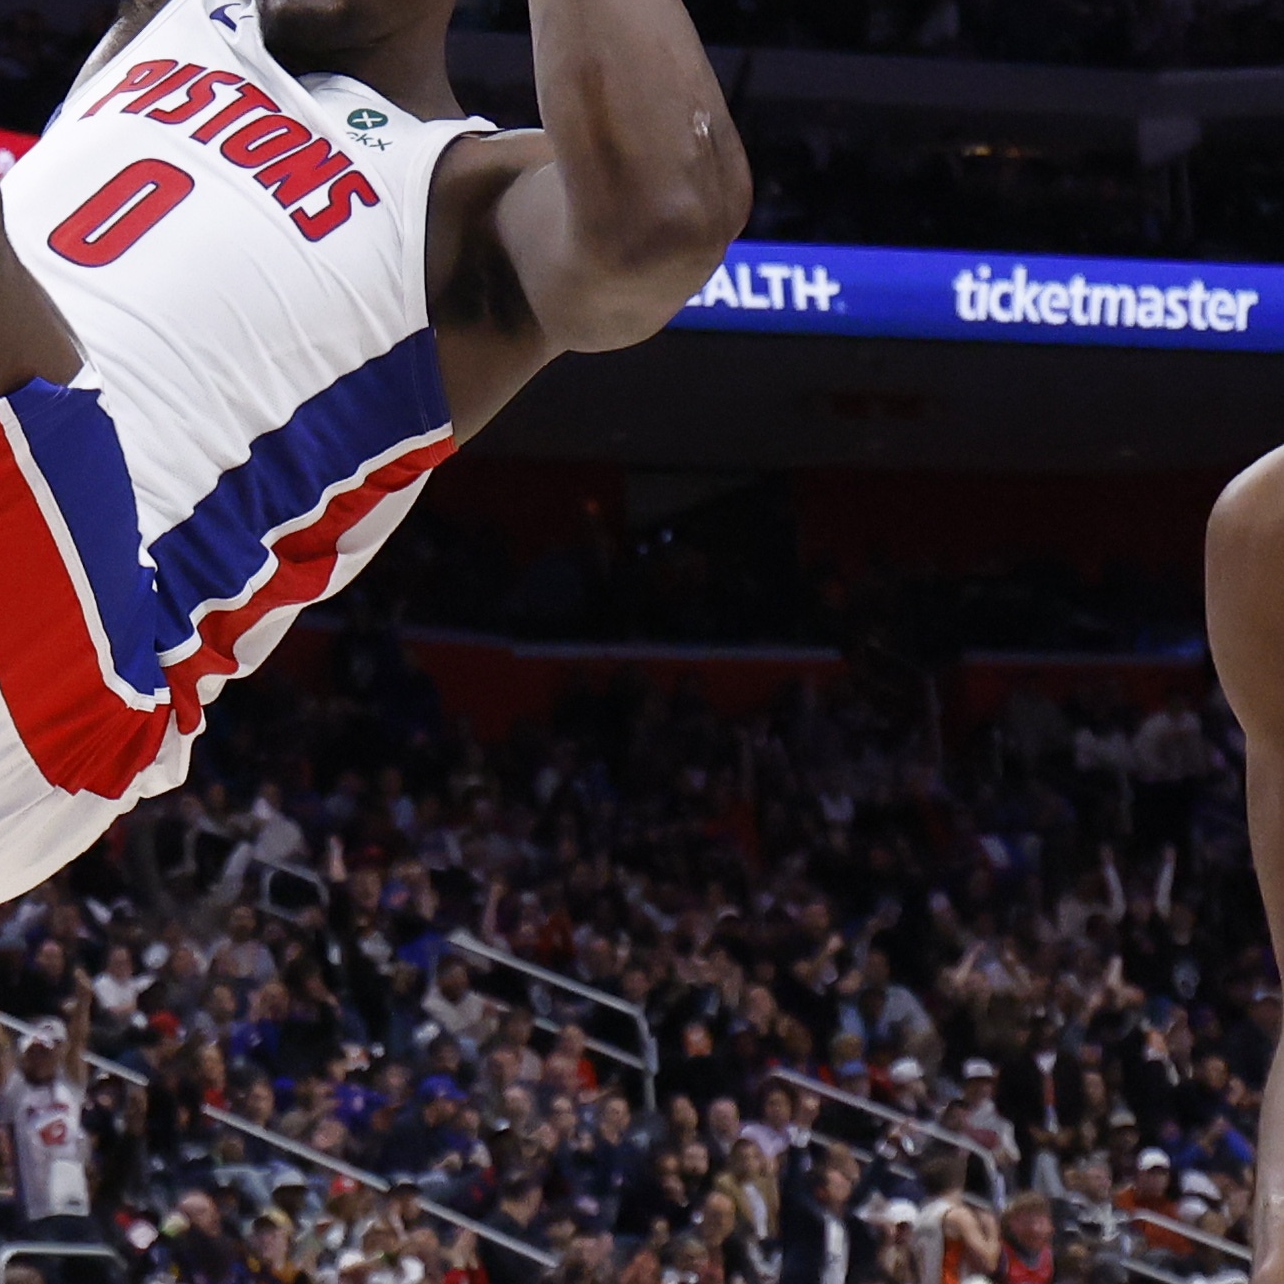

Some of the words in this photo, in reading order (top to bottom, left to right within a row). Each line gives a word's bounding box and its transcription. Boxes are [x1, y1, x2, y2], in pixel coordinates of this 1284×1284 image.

[78, 58, 381, 242] PISTONS
[47, 158, 195, 268] 0
[953, 263, 1261, 333] ticketmaster
